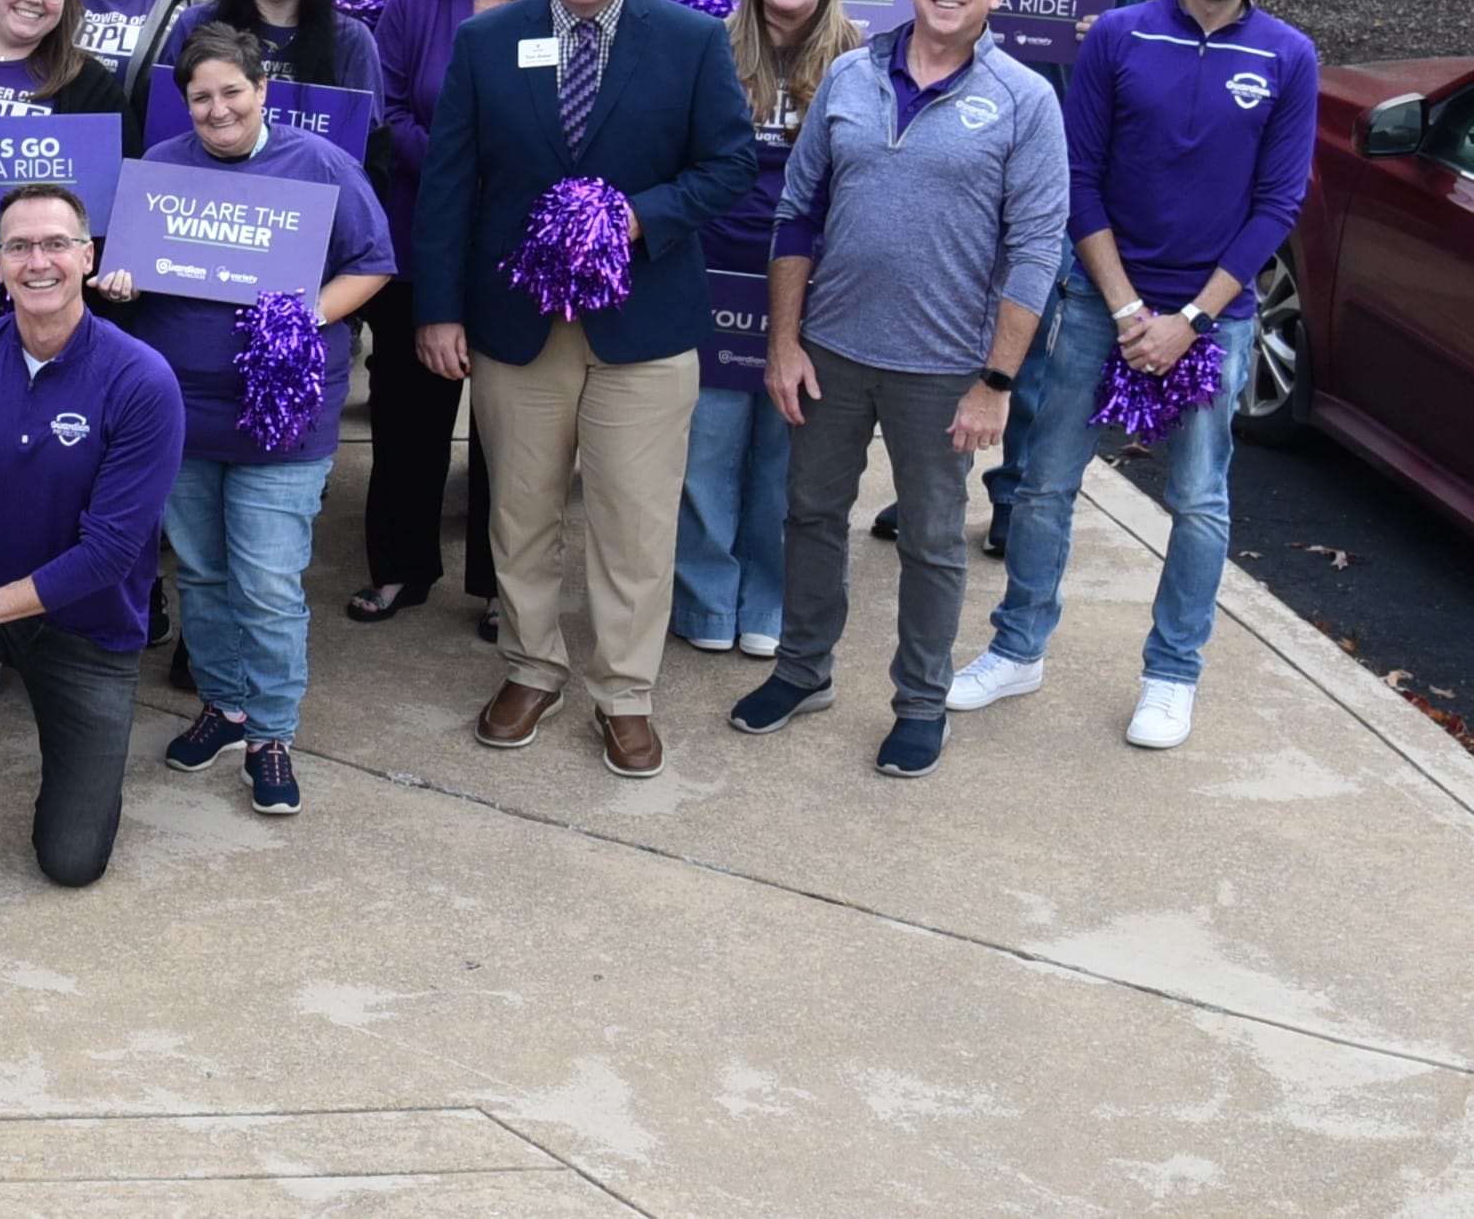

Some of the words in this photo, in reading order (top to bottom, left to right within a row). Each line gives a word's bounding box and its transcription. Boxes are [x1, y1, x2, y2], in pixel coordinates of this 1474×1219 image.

[129, 13, 147, 26] OF
[1225, 79, 1271, 98] Guardian
[287, 110, 332, 134] THE
[20, 137, 60, 158] GO
[14, 158, 73, 179] RIDE!
[146, 192, 197, 216] YOU
[201, 200, 248, 223] ARE
[254, 206, 301, 231] THE
[166, 215, 272, 247] WINNER
[156, 257, 207, 277] Guardian
[229, 274, 258, 284] variety
